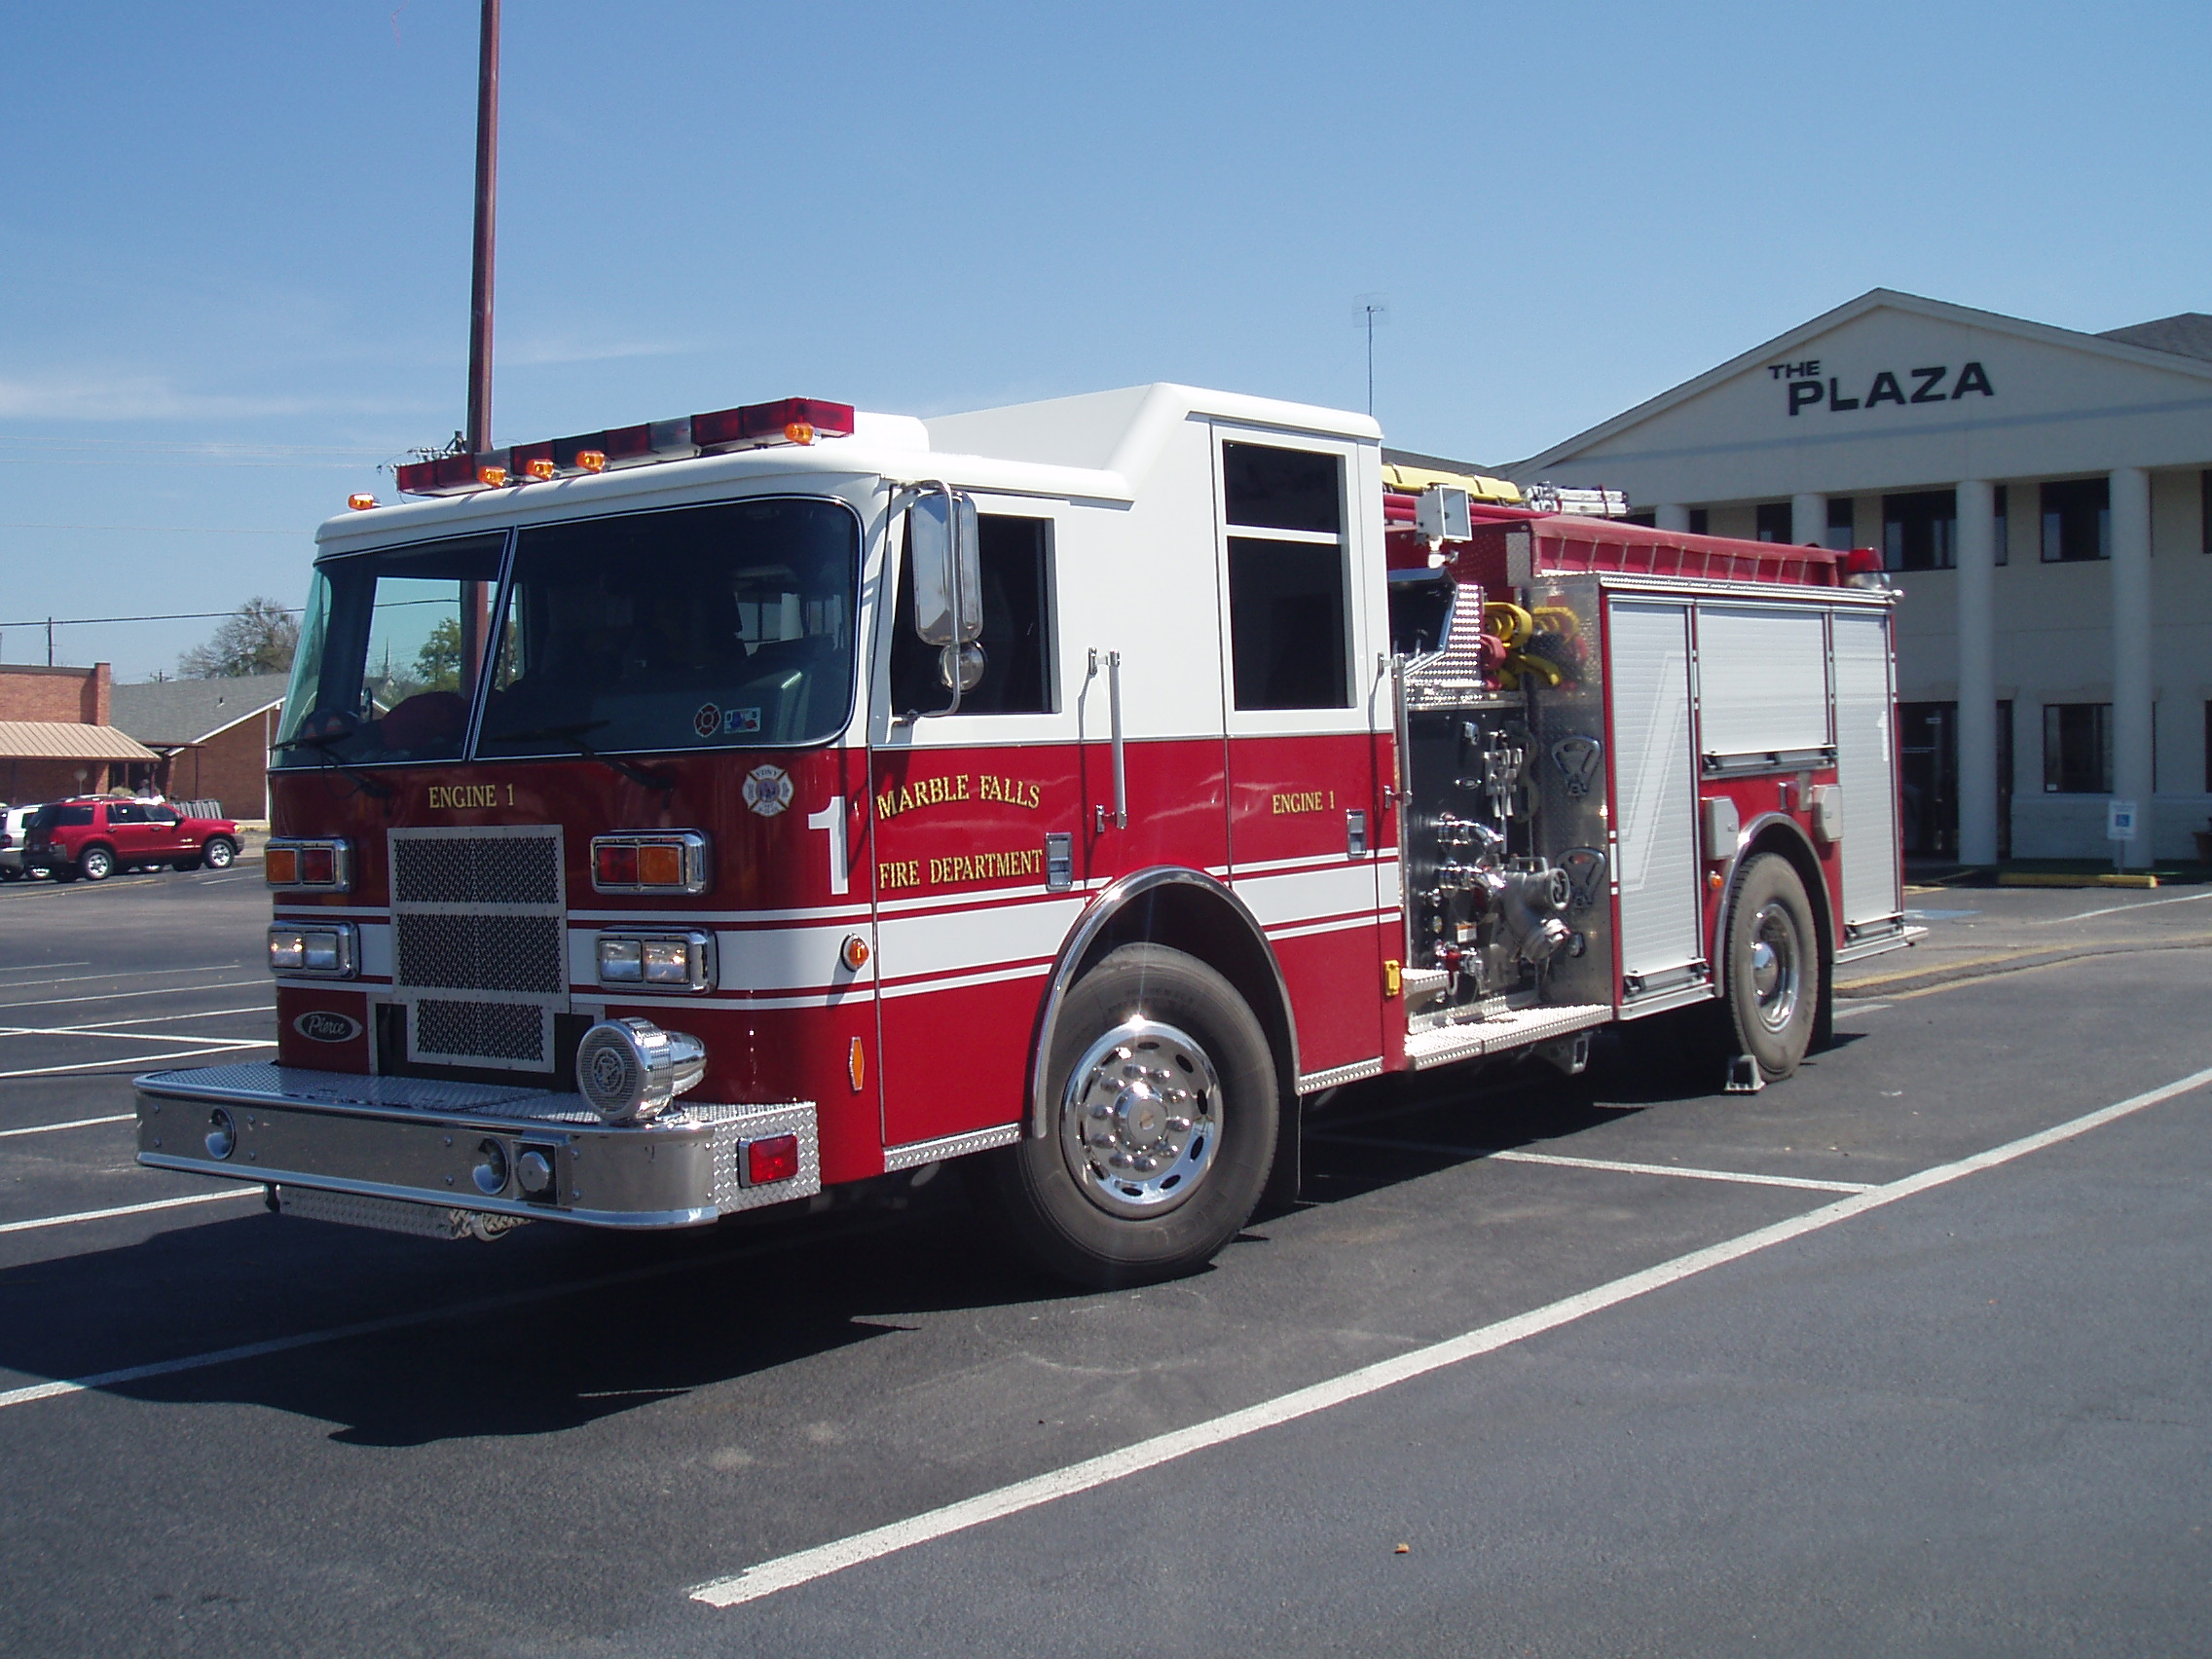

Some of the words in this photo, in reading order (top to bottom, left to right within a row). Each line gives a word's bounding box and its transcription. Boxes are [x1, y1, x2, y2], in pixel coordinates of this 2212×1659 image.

[1768, 360, 1821, 379] THE
[1788, 361, 1994, 416] PLAZA
[428, 785, 498, 808] ENGINE
[506, 784, 514, 806] 1
[877, 774, 970, 820] MARBLE
[979, 775, 1040, 809] FALLS
[1272, 792, 1323, 814] ENGINE
[1329, 790, 1335, 810] 1
[808, 795, 849, 895] 1
[879, 860, 920, 889] FIRE
[930, 849, 1043, 885] DEPARTMENT
[308, 1014, 346, 1035] Pierce
